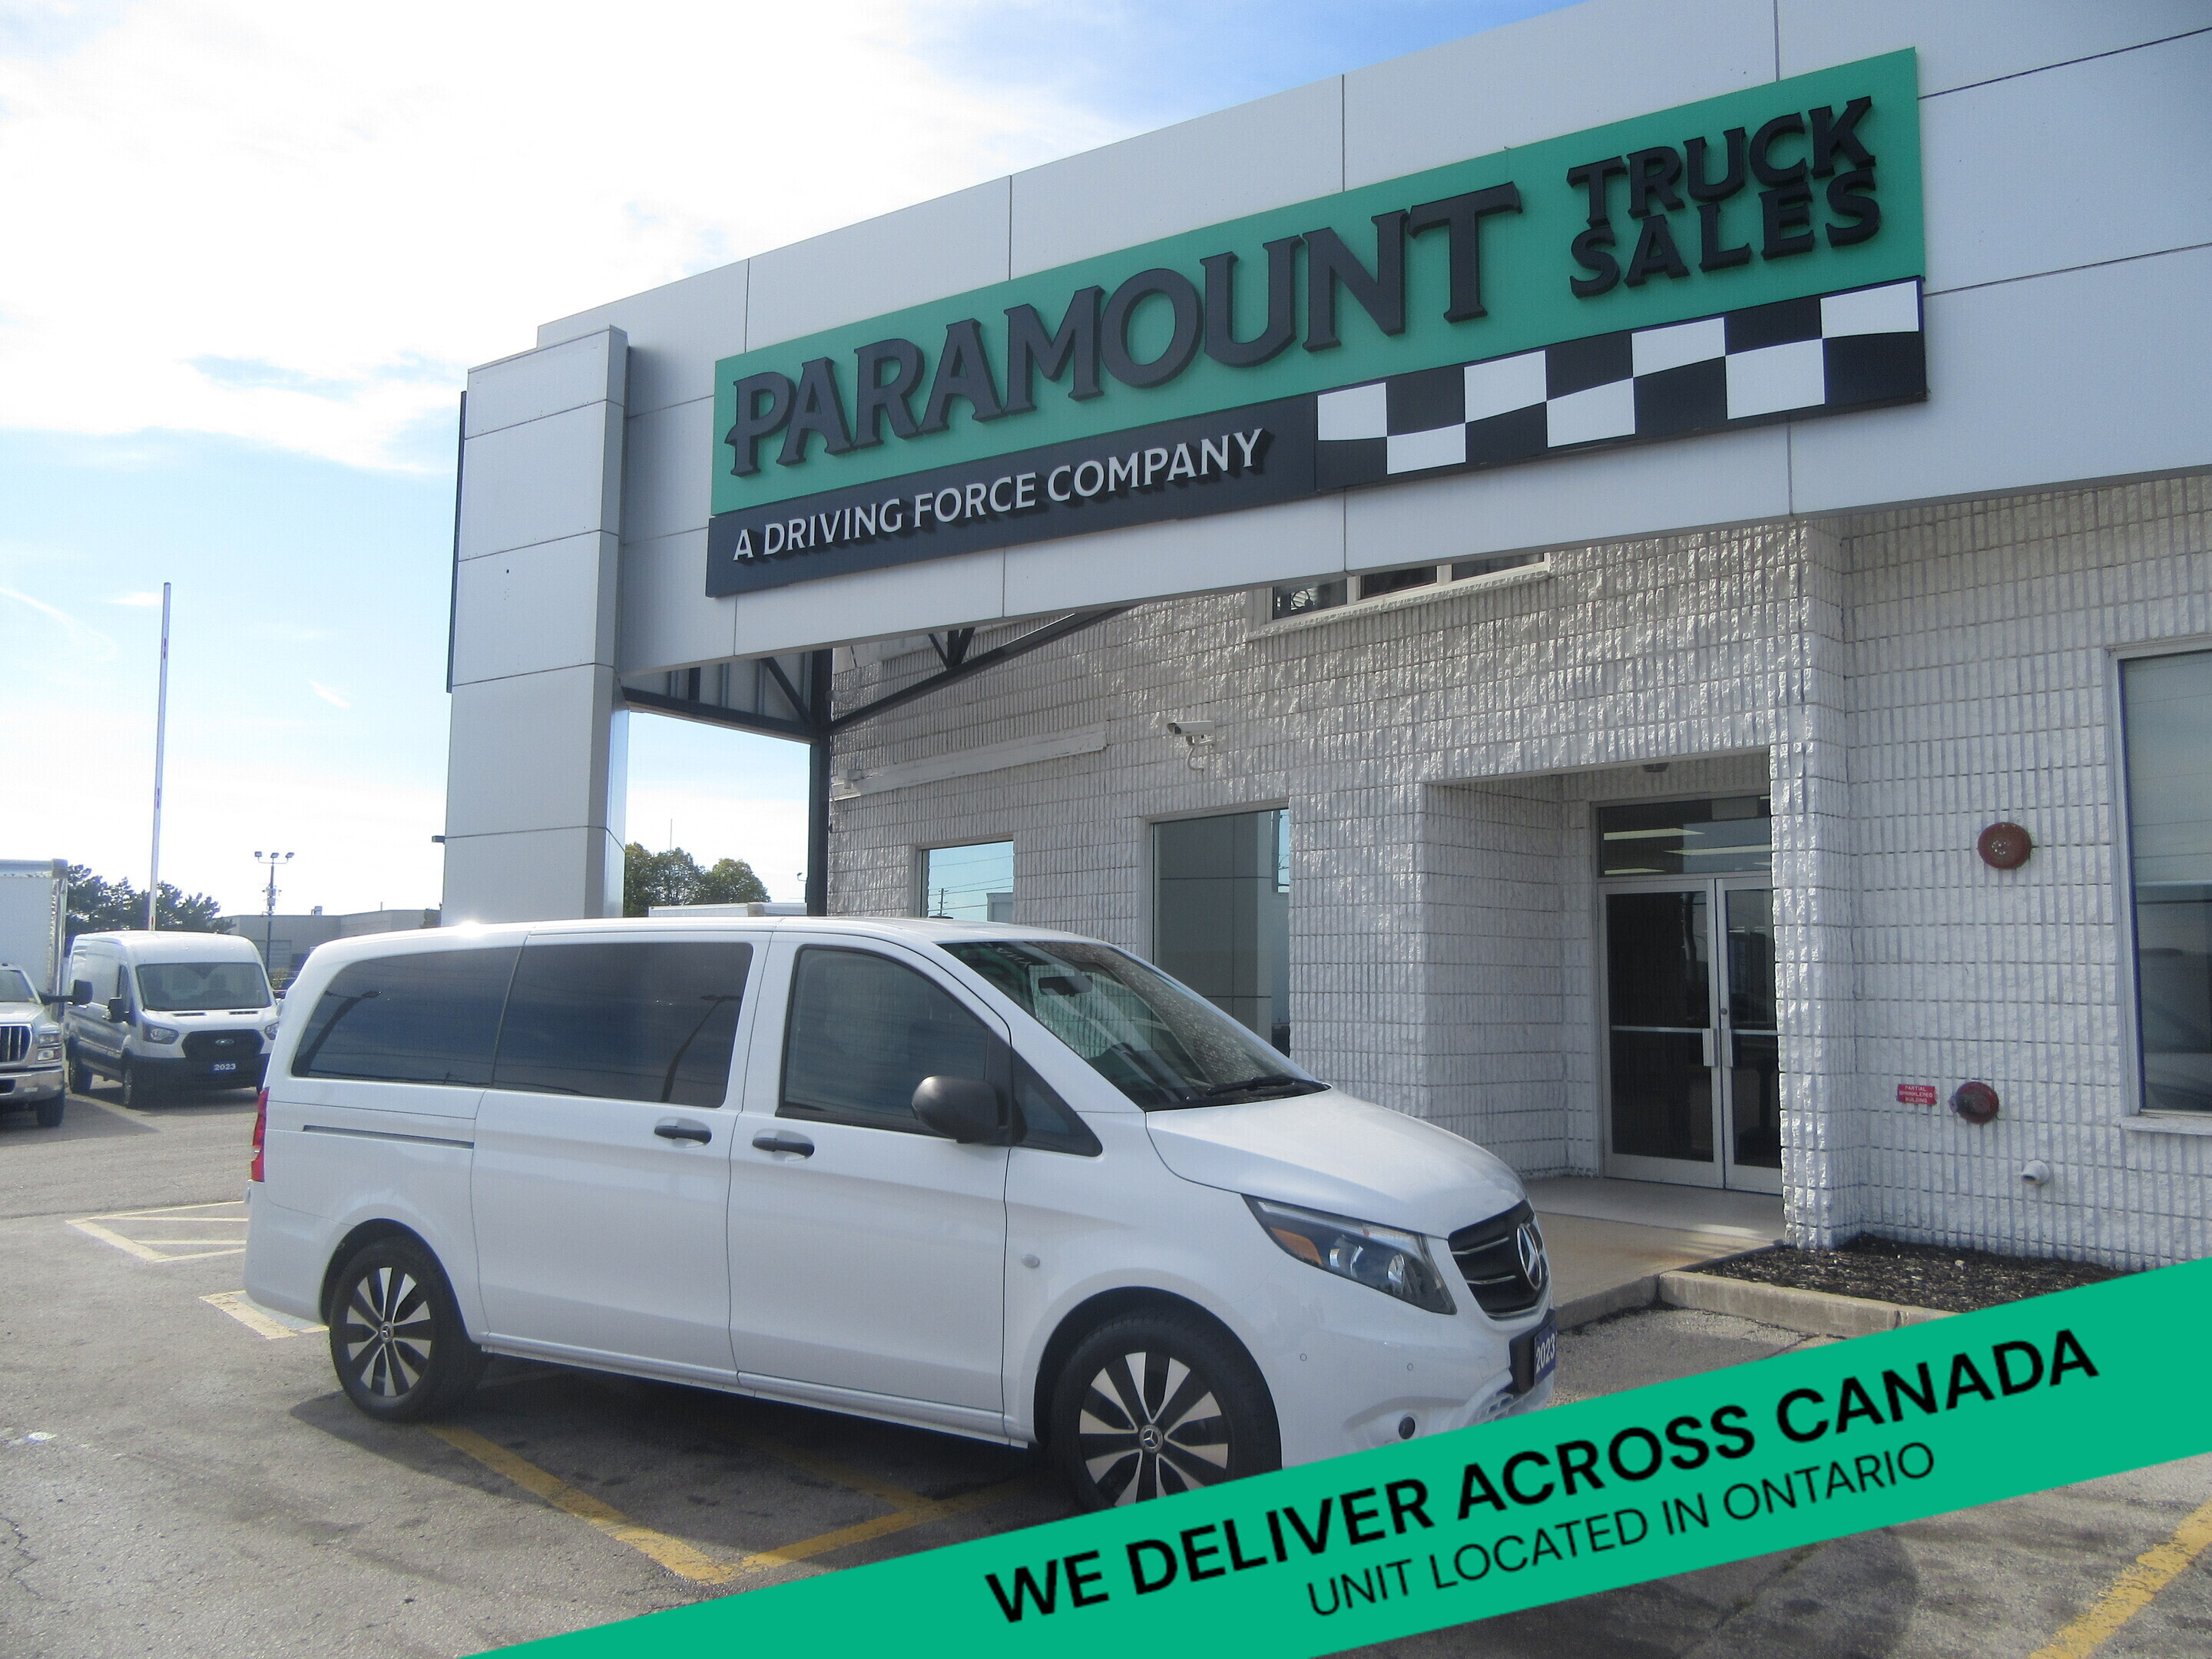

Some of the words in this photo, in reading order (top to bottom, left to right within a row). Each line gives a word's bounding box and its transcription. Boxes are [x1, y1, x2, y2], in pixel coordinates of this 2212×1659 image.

[1566, 96, 1876, 228] TRUCK
[1569, 167, 1881, 298] SALES
[724, 181, 1523, 478] PARAMOUNT
[733, 528, 754, 561] A
[763, 498, 904, 556] DRIVING
[913, 472, 1037, 529] FORCE
[1047, 428, 1265, 504] COMPANY
[1536, 1333, 1555, 1374] 2023
